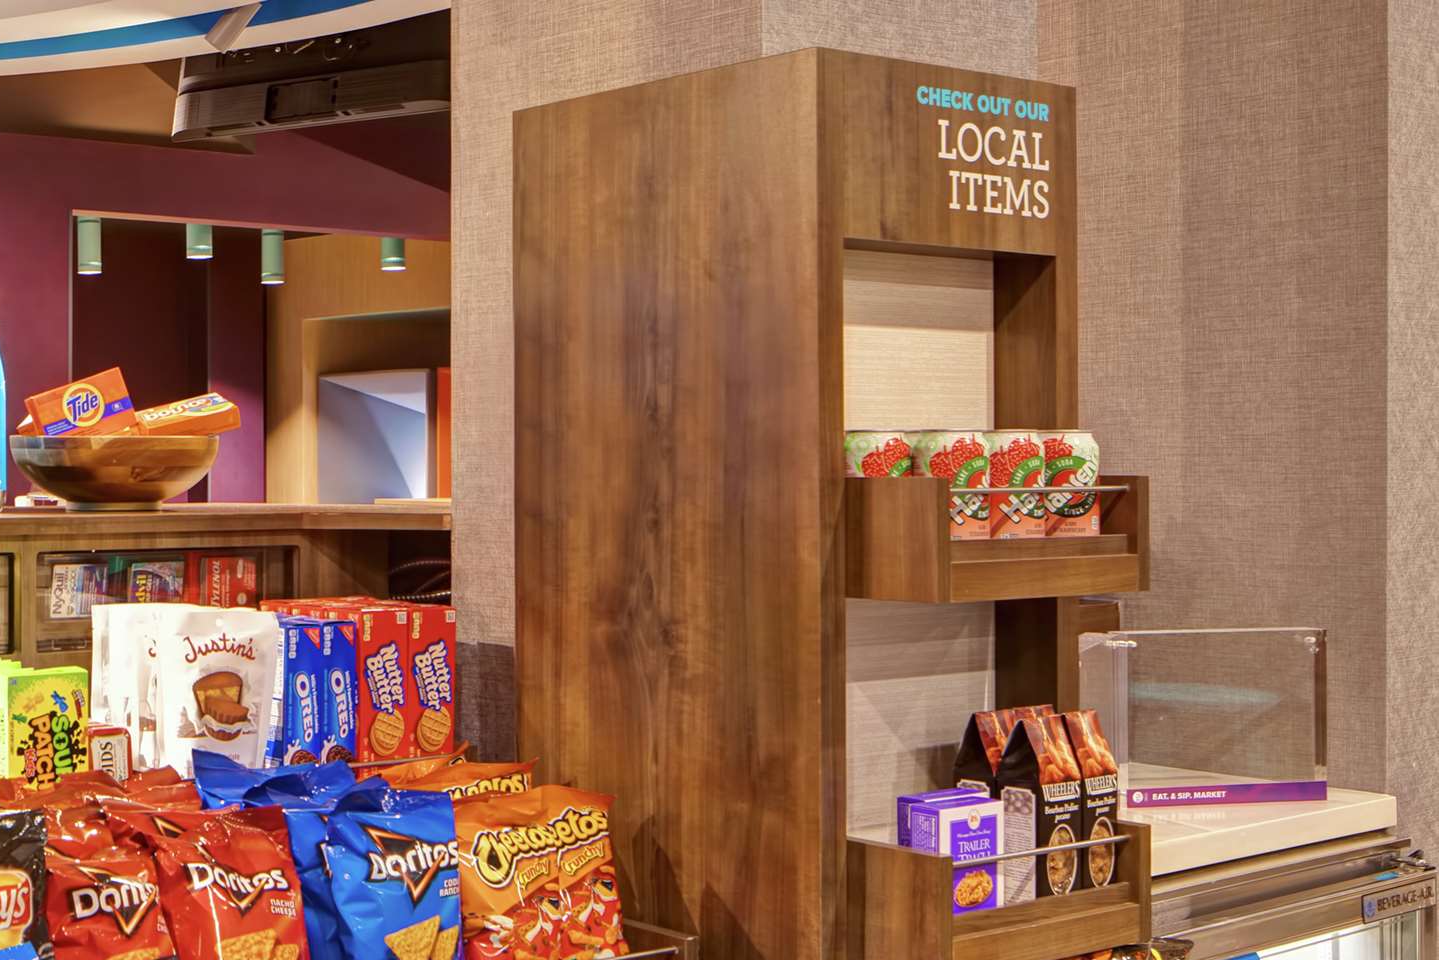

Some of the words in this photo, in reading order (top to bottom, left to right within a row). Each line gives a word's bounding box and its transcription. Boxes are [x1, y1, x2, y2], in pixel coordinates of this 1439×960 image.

[916, 85, 974, 111] CHECK
[977, 95, 1011, 117] OUT
[1015, 100, 1050, 122] OUR
[937, 119, 1050, 171] LOCAL
[948, 170, 1050, 219] ITEMS
[67, 392, 99, 422] Tide
[52, 572, 65, 615] NyQuil
[211, 559, 222, 608] TYLENOL
[184, 632, 257, 663] Justin's
[366, 655, 394, 714] Butter
[381, 643, 404, 705] Nutter
[414, 653, 441, 712] Butter
[428, 639, 452, 704] Nutter
[294, 672, 313, 744] OREO
[330, 667, 349, 739] OREO
[31, 713, 52, 791] PATCH
[1152, 793, 1169, 801] EAT.
[1170, 792, 1176, 800] &
[1193, 790, 1227, 799] MARKET
[369, 837, 460, 882] Doritos
[561, 842, 604, 875] Crunchy
[958, 838, 991, 854] TRAILER
[186, 862, 290, 895] Doritos
[270, 899, 296, 910] NACHO
[270, 906, 298, 918] CHEESE
